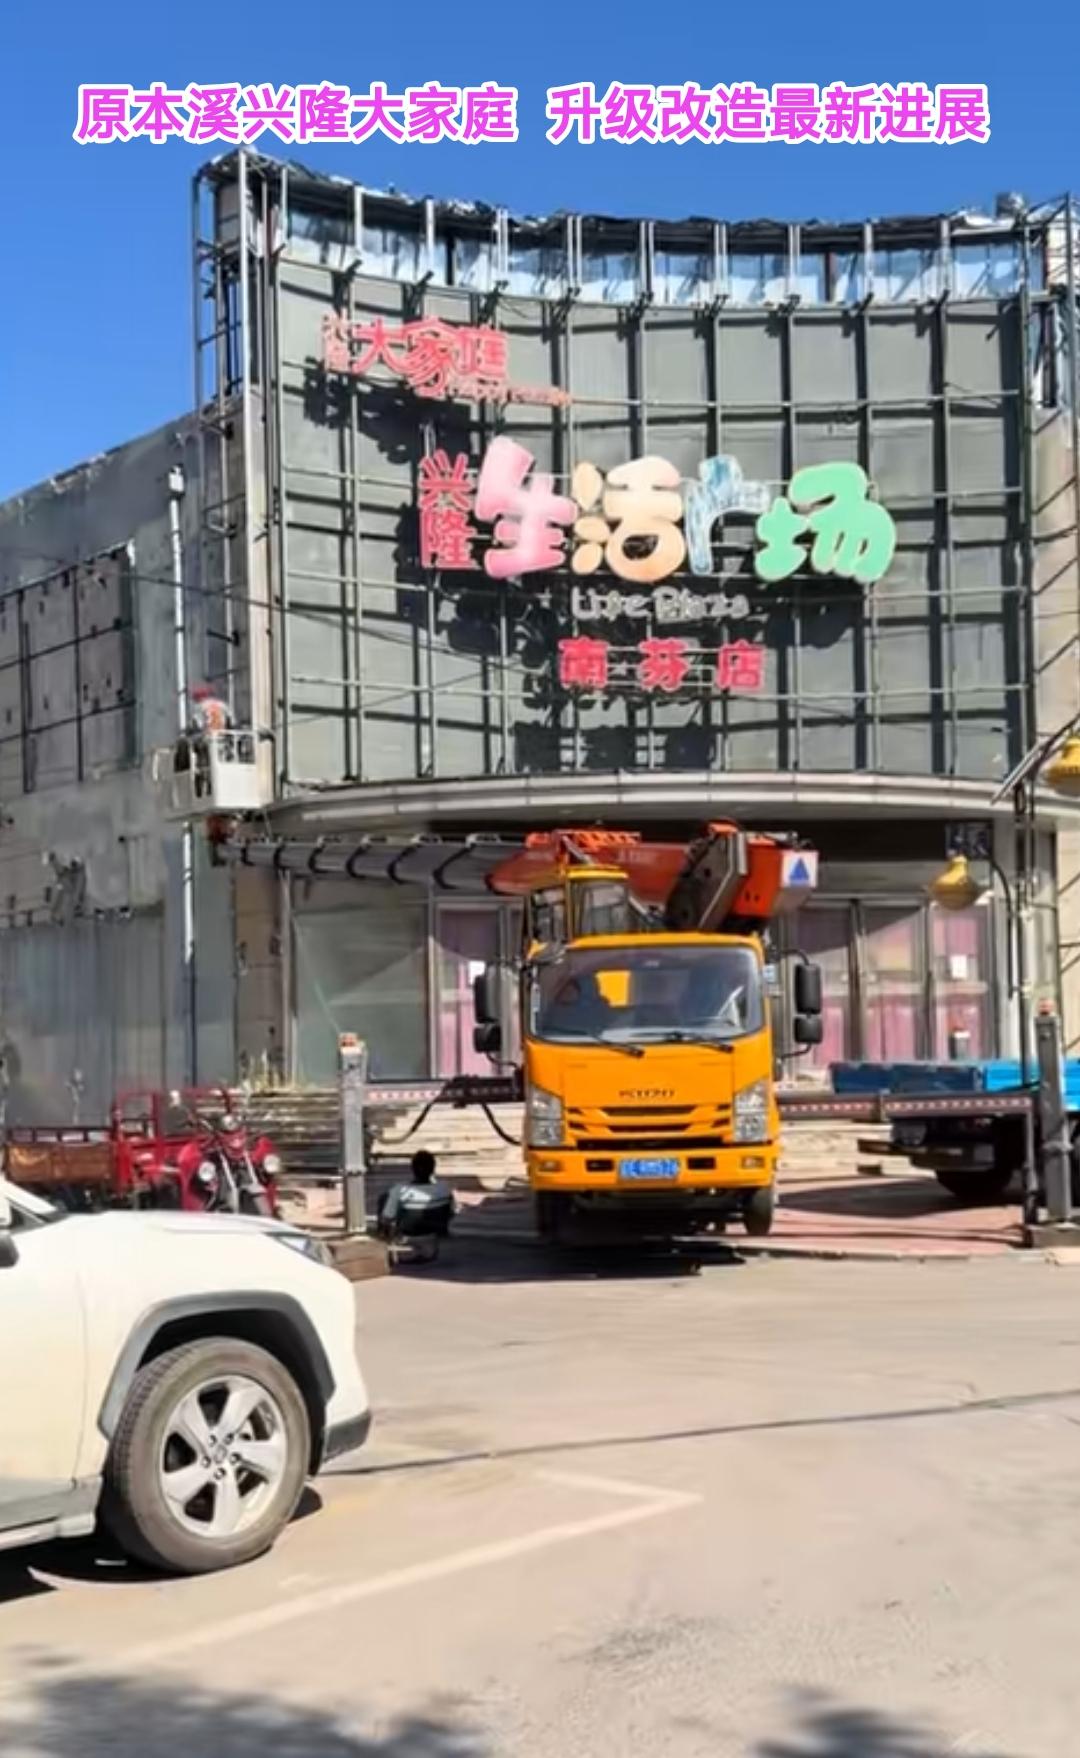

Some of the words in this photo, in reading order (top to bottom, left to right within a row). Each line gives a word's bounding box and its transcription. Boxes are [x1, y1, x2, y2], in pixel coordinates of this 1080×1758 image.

[351, 317, 508, 398] 大家庭
[418, 449, 476, 569] 兴隆
[476, 436, 895, 582] 生活广场
[558, 635, 766, 691] 南芬店
